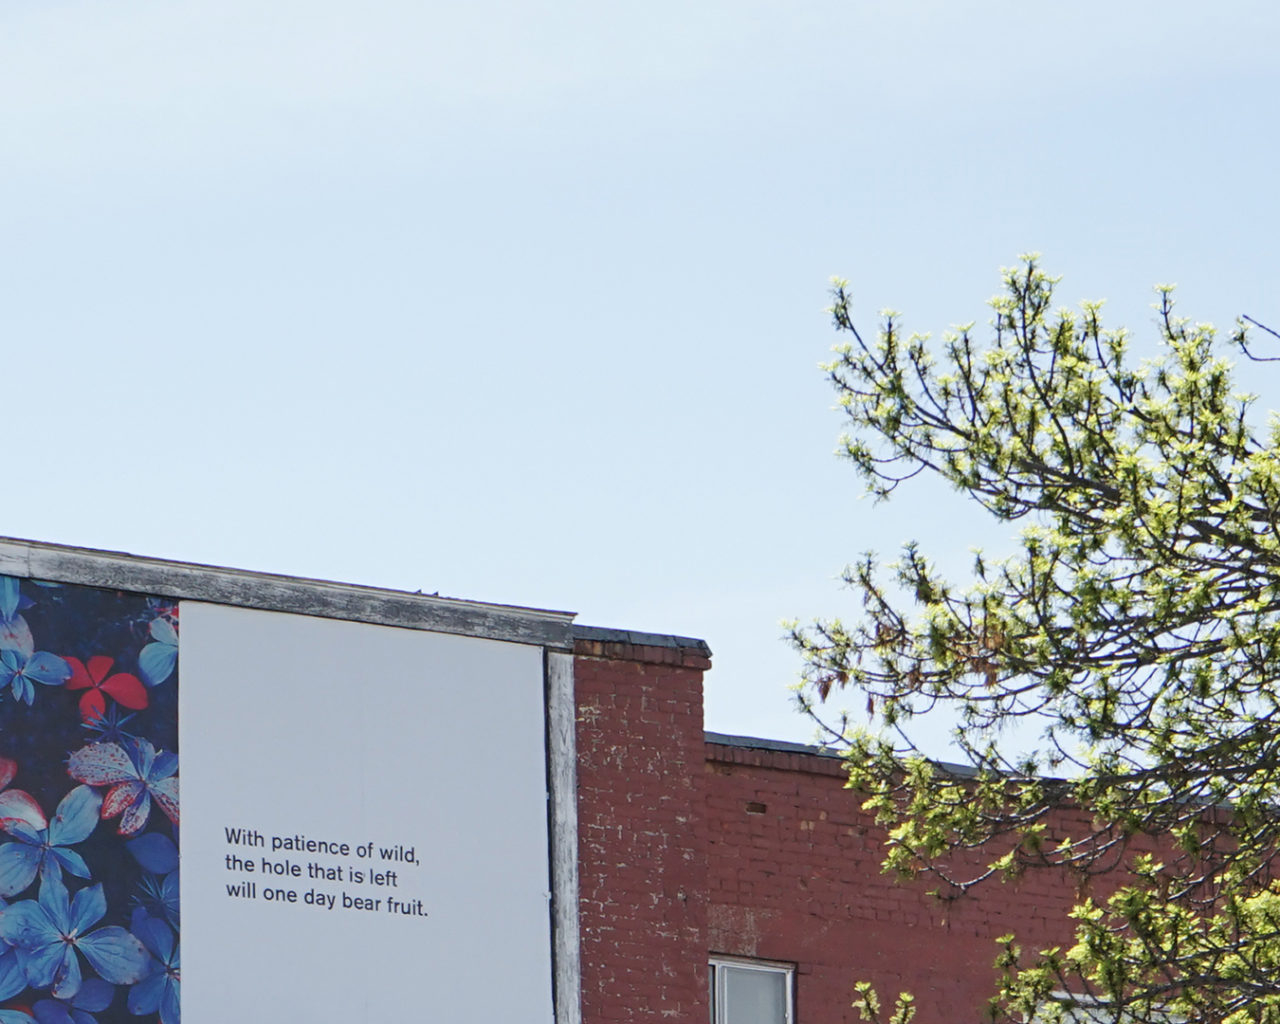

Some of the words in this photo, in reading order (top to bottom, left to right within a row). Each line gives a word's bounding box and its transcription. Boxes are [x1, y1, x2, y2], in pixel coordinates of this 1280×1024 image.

[224, 827, 265, 848] With
[271, 834, 350, 857] patience
[356, 842, 374, 859] of
[379, 845, 420, 866] wild,
[225, 855, 255, 873] the
[261, 859, 302, 878] hole
[307, 862, 343, 881] that
[349, 867, 364, 884] is
[369, 869, 398, 888] left
[226, 882, 256, 900] will
[263, 887, 297, 903] one
[304, 889, 335, 910] day
[342, 892, 381, 912] bear
[387, 897, 428, 917] fruit.
